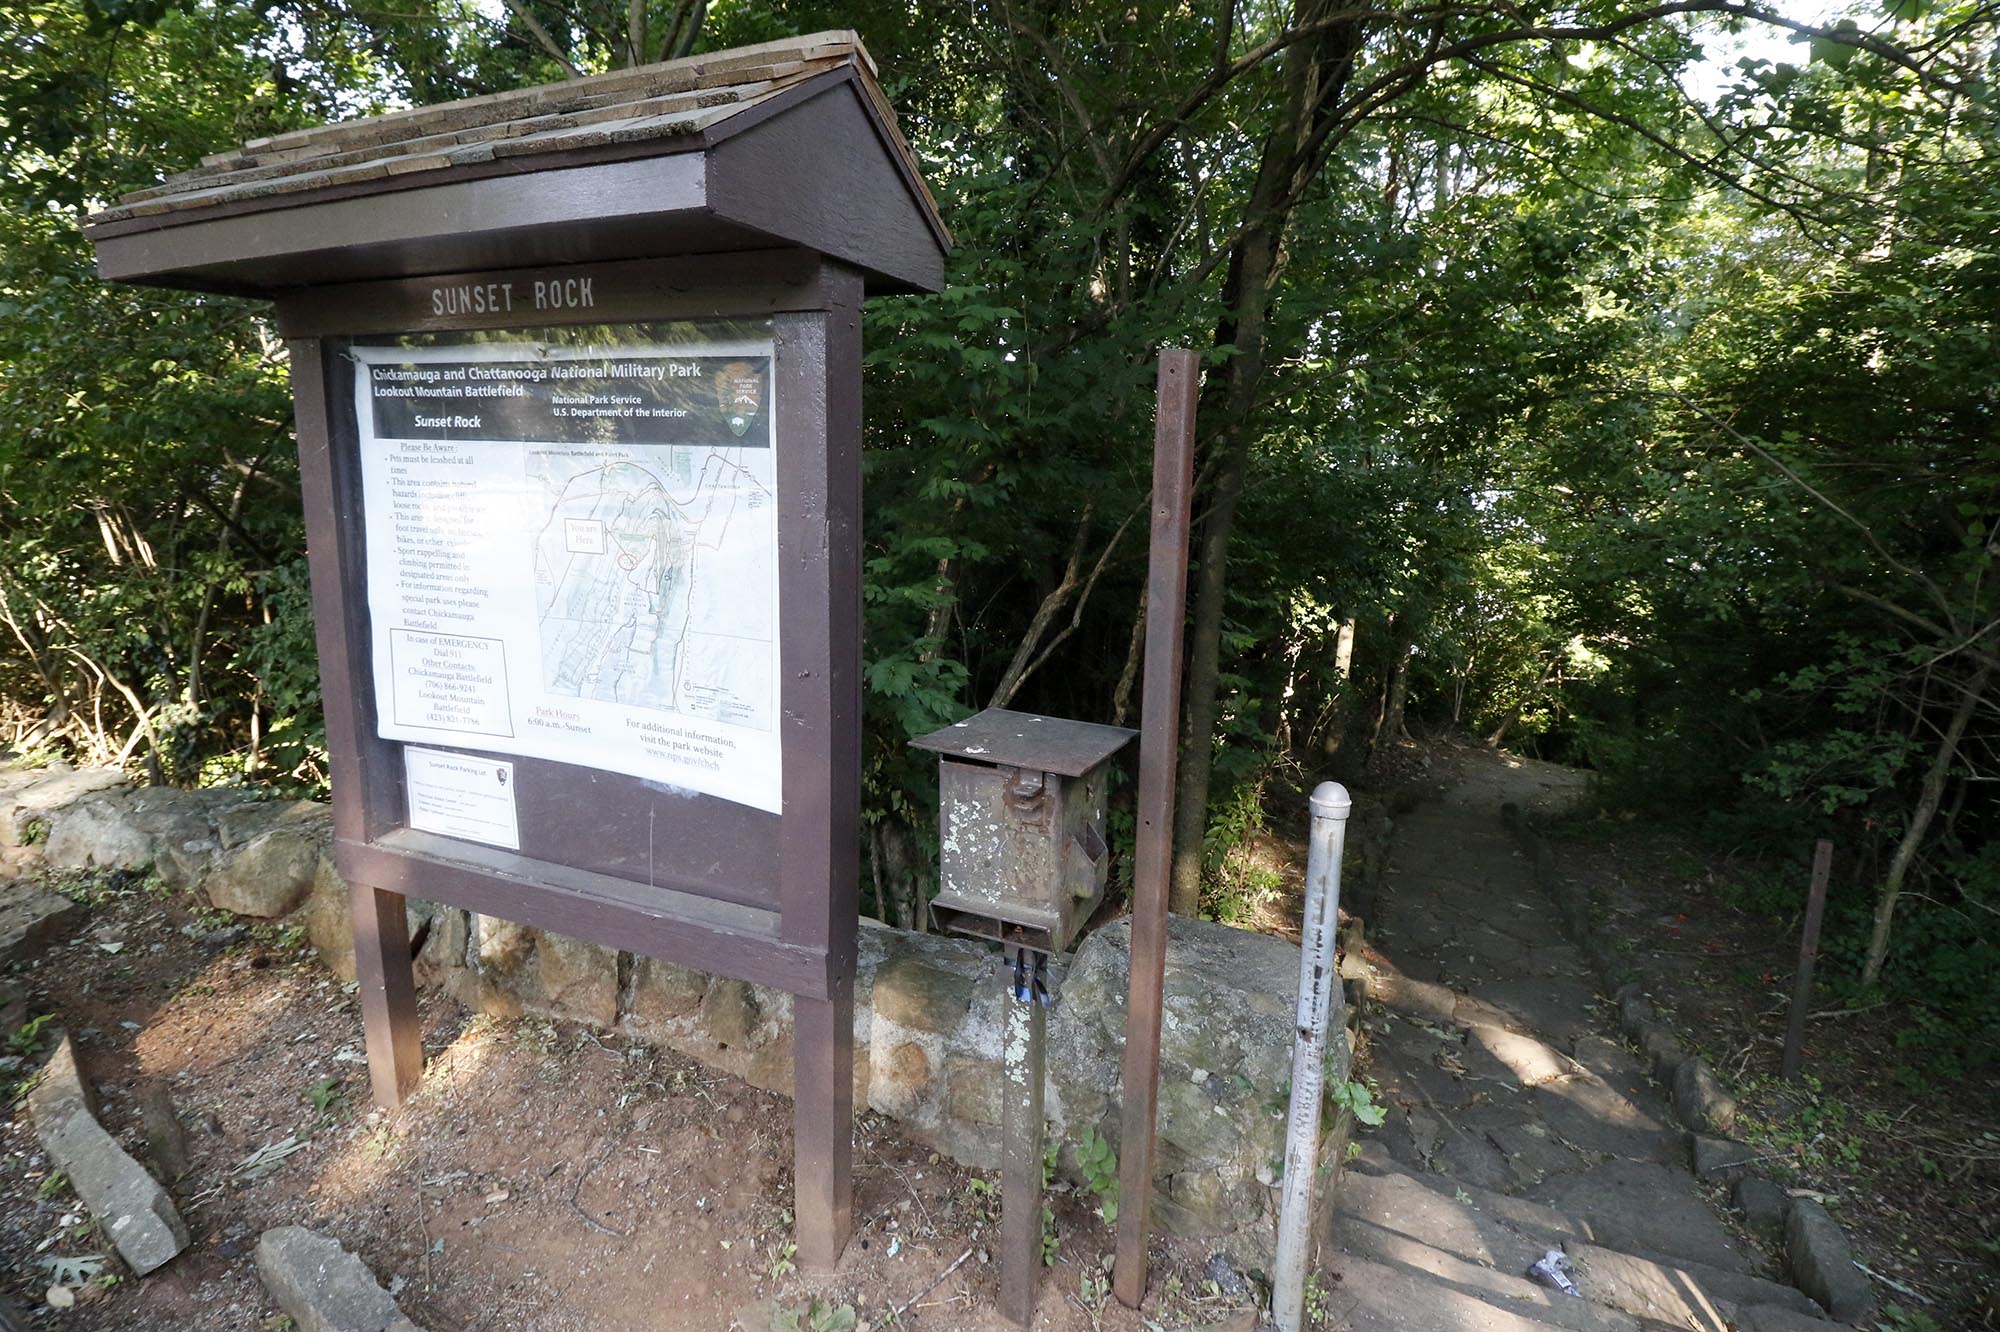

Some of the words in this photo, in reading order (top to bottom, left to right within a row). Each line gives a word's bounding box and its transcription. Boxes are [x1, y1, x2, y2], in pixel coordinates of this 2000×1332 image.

[432, 284, 512, 315] SUNSET
[534, 278, 594, 310] ROCK
[373, 369, 440, 383] Chickamauga
[444, 368, 465, 380] and
[468, 367, 547, 382] Chattanooga
[551, 365, 607, 378] National
[611, 364, 665, 381] Military
[669, 363, 701, 377] Park
[374, 386, 415, 397] Lookout
[415, 386, 463, 397] Mountain
[465, 385, 524, 397] Battlefield
[552, 395, 588, 404] National
[590, 395, 608, 404] Park
[610, 395, 642, 404] Service
[553, 408, 569, 417] U.S.
[571, 408, 622, 418] Department
[624, 408, 633, 417] of
[635, 408, 650, 417] the
[652, 408, 687, 417] Interior
[415, 415, 452, 427] Sunset
[454, 415, 481, 428] Rock
[400, 442, 421, 452] Please
[423, 443, 432, 452] Be
[421, 455, 429, 463] be
[439, 637, 489, 650] EMERGENCY
[536, 706, 553, 716] Park
[556, 708, 580, 720] Hours
[528, 717, 544, 727] 6:00
[626, 718, 640, 729] For
[641, 722, 683, 737] additional
[684, 728, 737, 749] information,
[640, 734, 656, 744] visit
[658, 736, 670, 747] the
[672, 740, 691, 751] park
[693, 745, 724, 758] website
